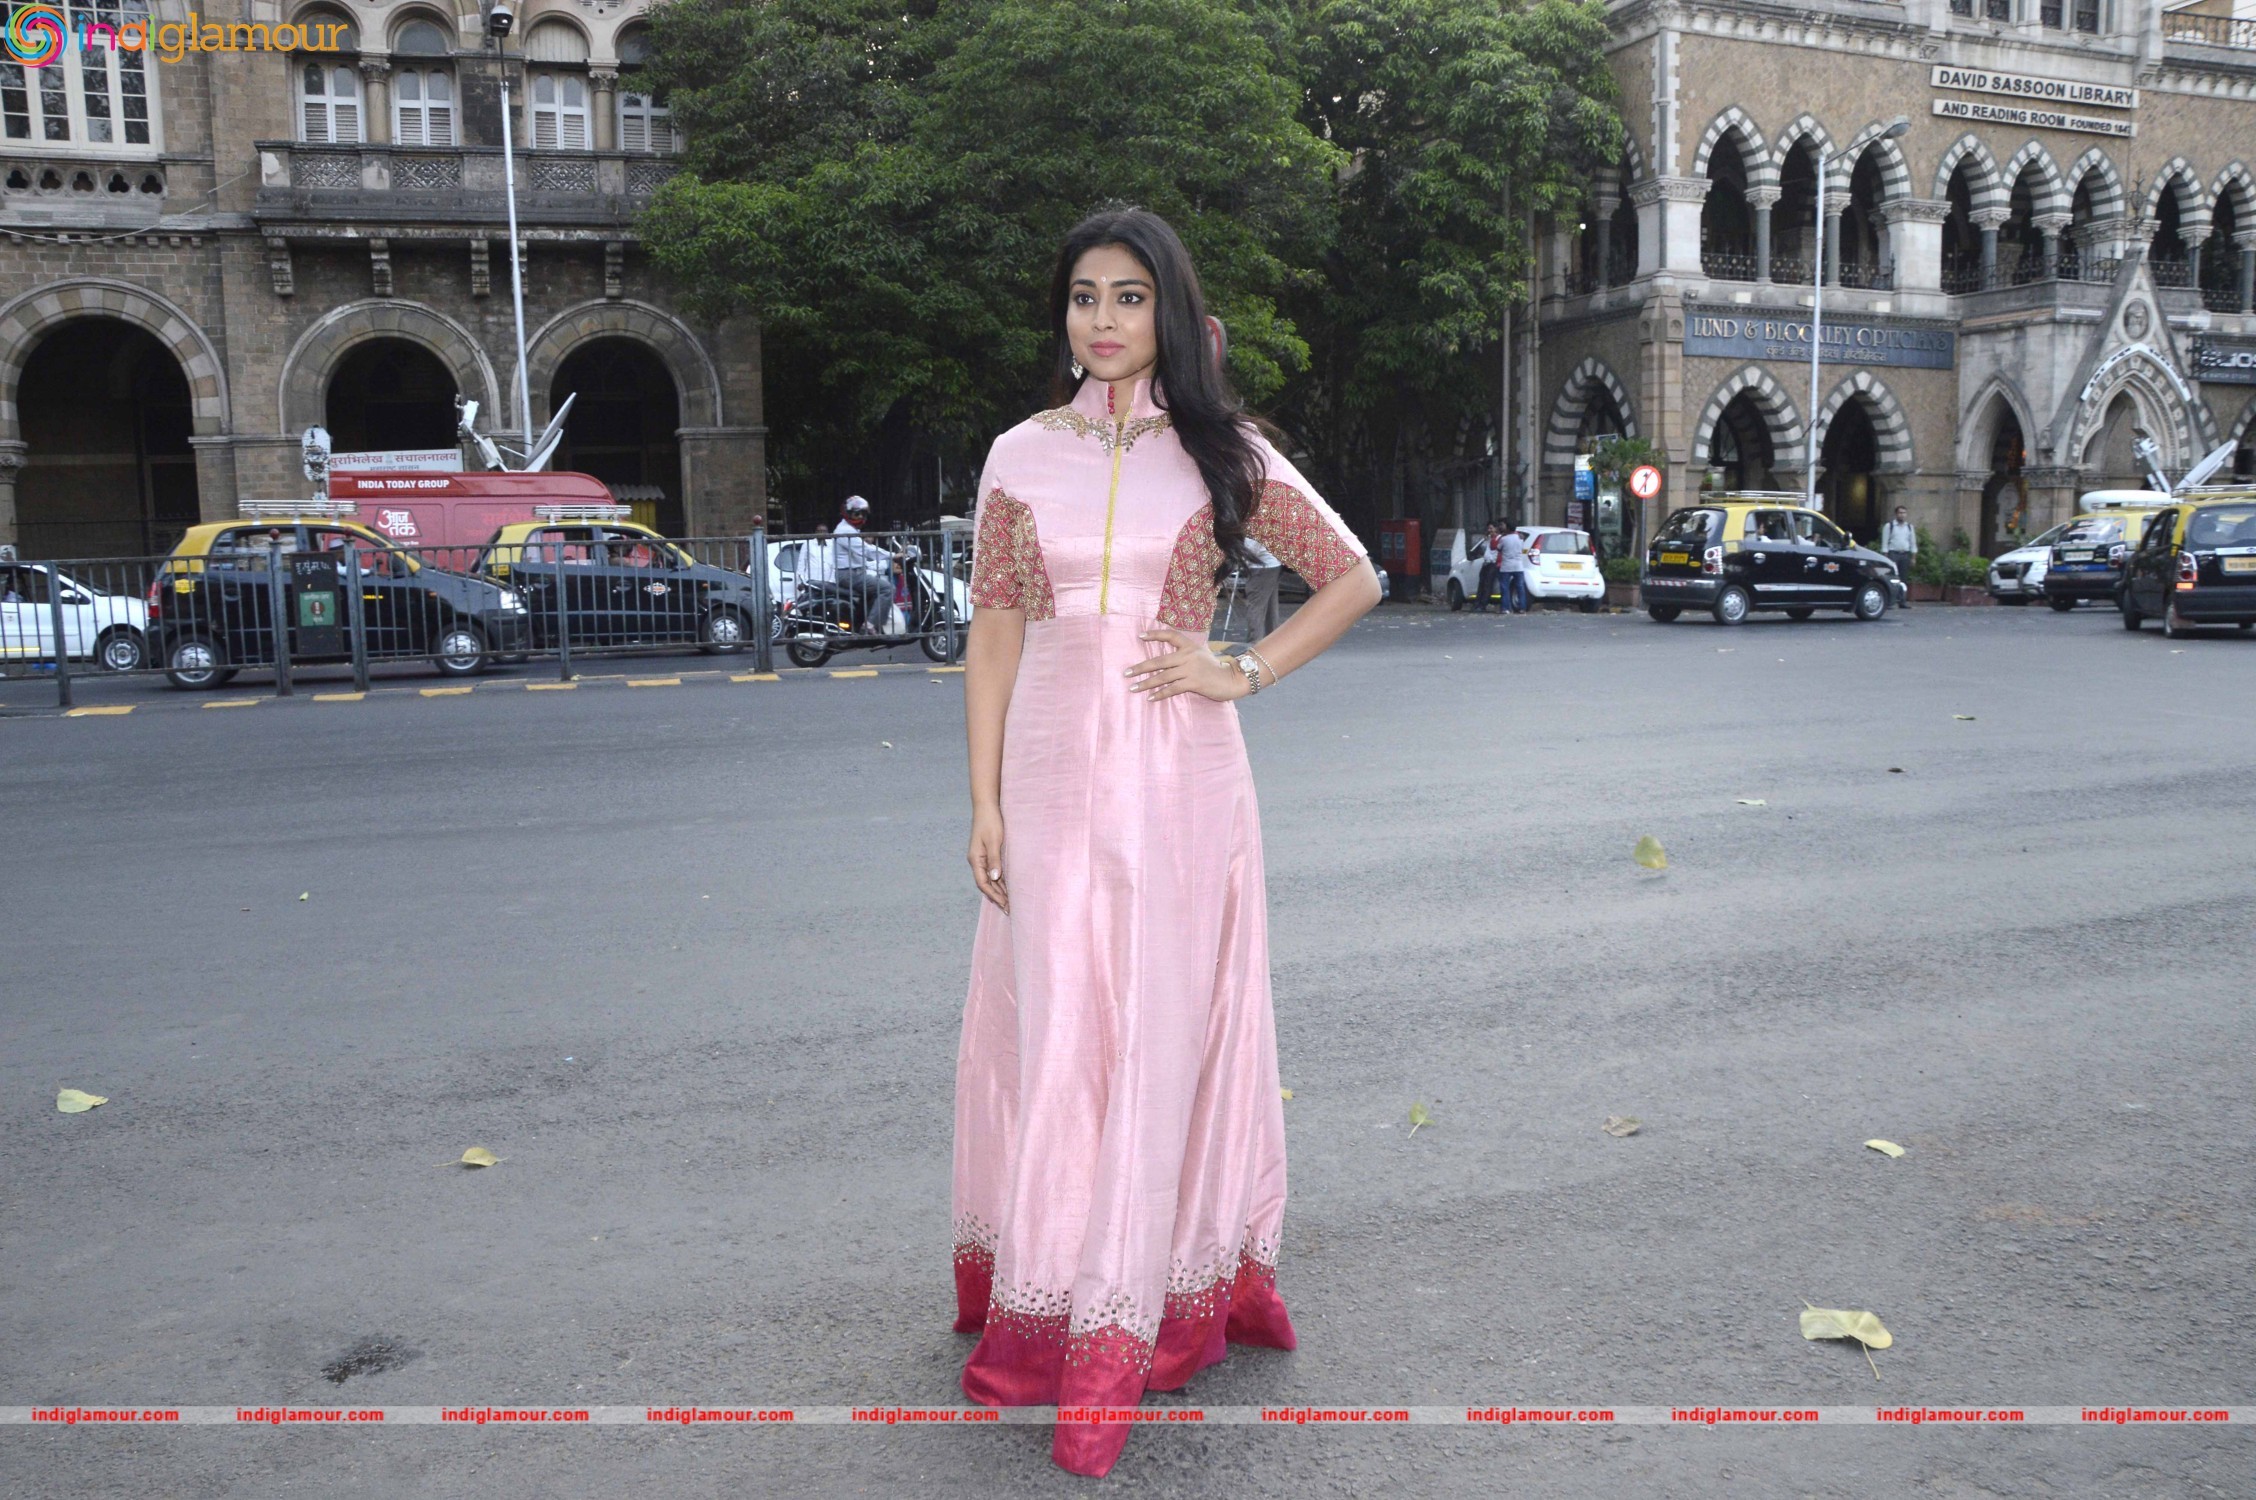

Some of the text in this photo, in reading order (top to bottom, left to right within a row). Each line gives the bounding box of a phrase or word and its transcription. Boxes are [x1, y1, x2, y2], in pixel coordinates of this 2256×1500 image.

[1939, 70, 2133, 105] DAVID SASSOON LIBRARY
[1941, 102, 1968, 116] AND
[1972, 105, 2027, 123] READING
[2030, 113, 2065, 127] ROOM
[2070, 119, 2112, 133] FOUNDED
[1693, 317, 1739, 338] LUND
[1744, 320, 1759, 339] &
[357, 479, 450, 489] INDIA TODAY GROUP
[377, 510, 409, 528] आज
[388, 522, 416, 536] तक
